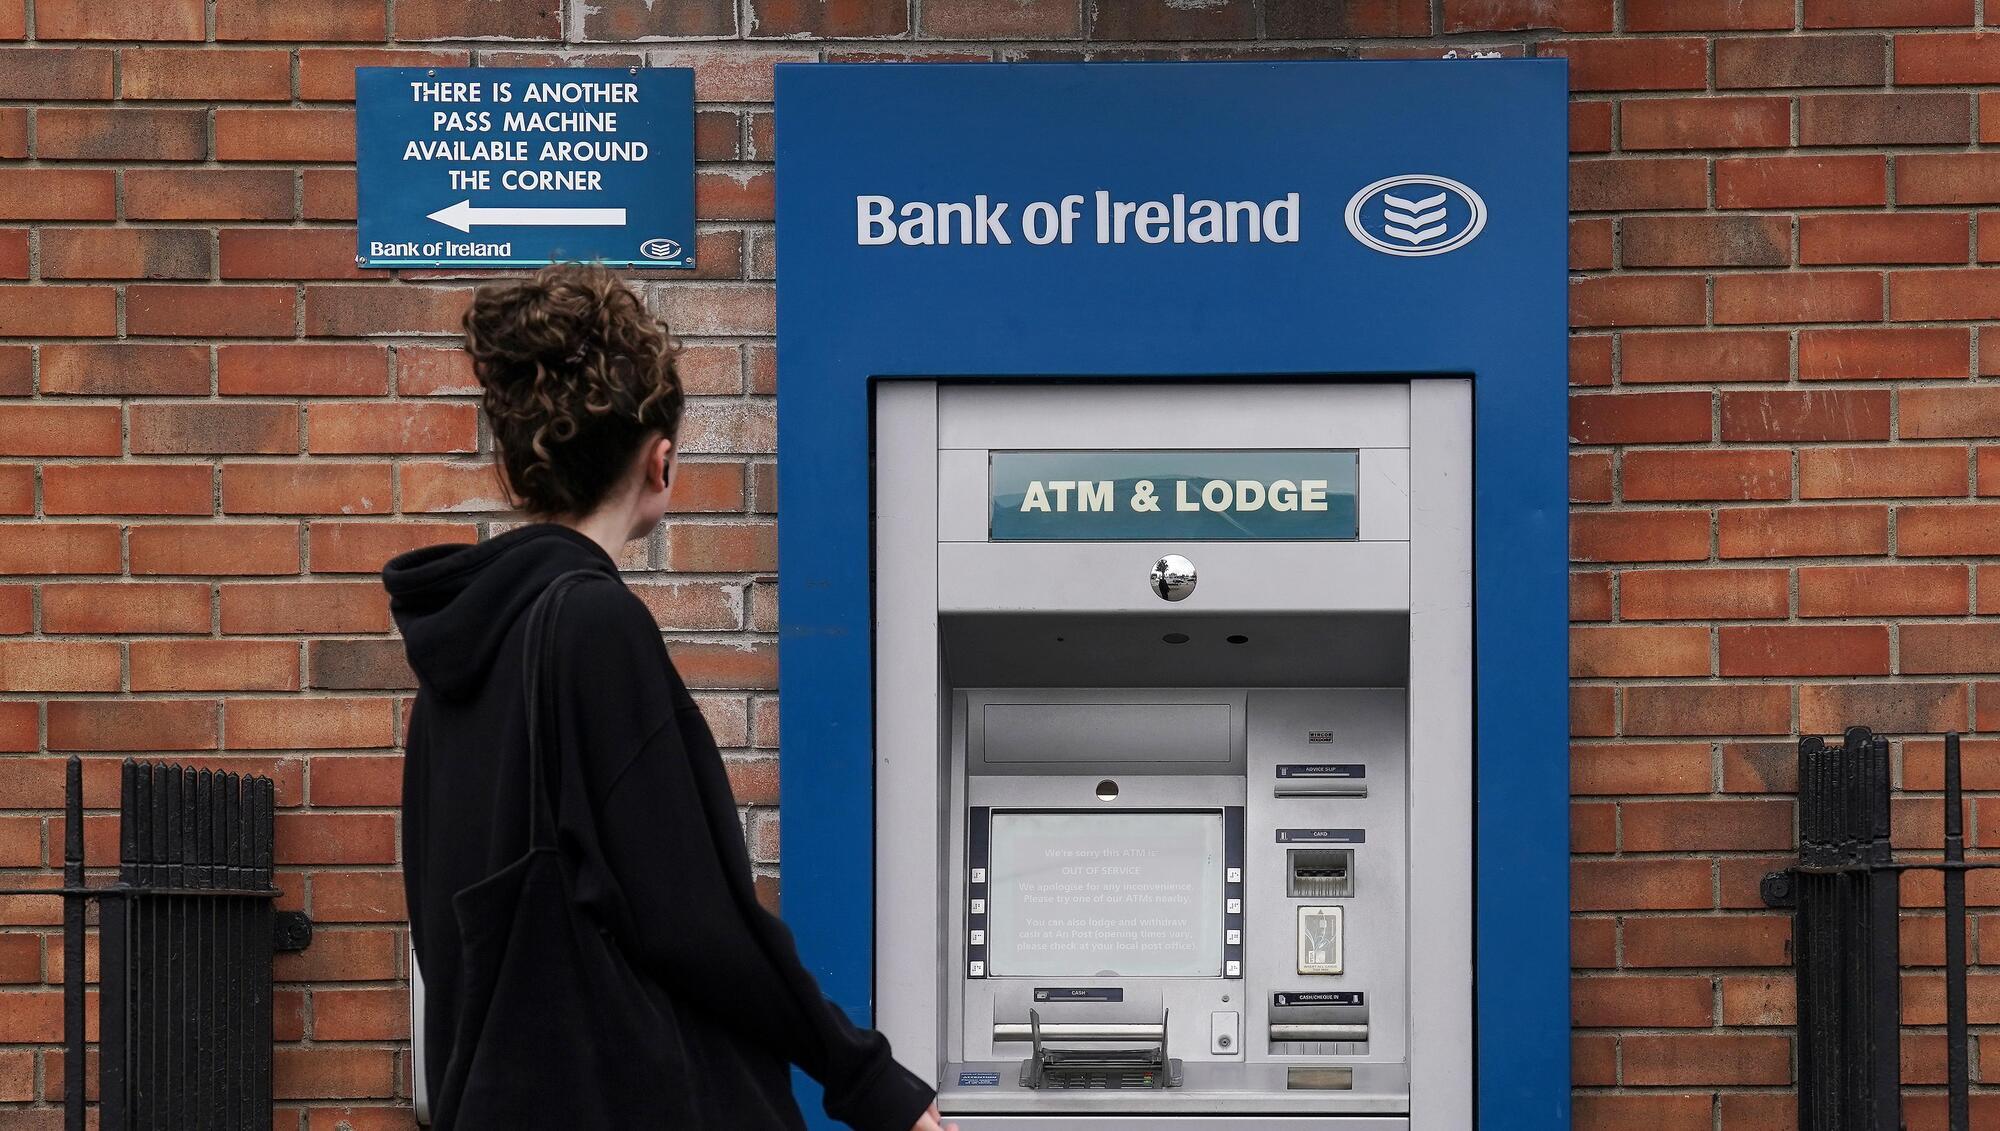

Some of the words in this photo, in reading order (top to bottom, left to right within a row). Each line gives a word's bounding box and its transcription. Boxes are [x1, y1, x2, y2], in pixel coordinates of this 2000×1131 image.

[411, 82, 481, 103] THERE
[493, 82, 512, 103] IS
[523, 82, 639, 103] ANOTHER
[433, 111, 491, 132] PASS
[503, 110, 617, 132] MACHINE
[402, 140, 528, 162] AVAILABLE
[539, 141, 648, 162] AROUND
[449, 170, 491, 190] THE
[502, 169, 603, 191] CORNER
[856, 194, 1012, 246] Bank
[1022, 194, 1085, 245] of
[1095, 190, 1300, 244] Ireland
[370, 241, 420, 257] Bank
[422, 241, 443, 257] of
[446, 241, 511, 257] Ireland
[1020, 480, 1114, 512] ATM
[1130, 479, 1161, 513] &
[1176, 479, 1328, 513] LODGE
[1044, 848, 1074, 858] We're
[1074, 850, 1099, 859] sorry
[1103, 848, 1120, 857] this
[1122, 848, 1146, 857] ATM
[1062, 866, 1084, 875] OUT
[1086, 866, 1101, 875] OF
[1102, 866, 1142, 875] SERVICE
[1018, 882, 1034, 891] We
[1036, 882, 1083, 893] apologise
[1086, 882, 1100, 891] for
[1103, 884, 1121, 893] any
[1024, 895, 1054, 904] Please
[1056, 895, 1072, 905] try
[1073, 896, 1091, 904] one
[1092, 895, 1105, 904] of
[1106, 896, 1123, 904] our
[1126, 895, 1153, 904] ATMs
[1025, 918, 1045, 927] You
[1047, 919, 1065, 927] can
[1066, 918, 1087, 927] also
[1088, 918, 1115, 929] lodge
[1118, 918, 1137, 927] and
[1139, 918, 1187, 927] withdraw
[1019, 929, 1040, 939] cash
[1043, 930, 1053, 939] at
[1055, 929, 1069, 939] An
[1071, 929, 1092, 939] Post
[1094, 929, 1138, 940] (opening
[1140, 929, 1166, 939] times
[1016, 942, 1048, 952] please
[1049, 942, 1078, 951] check
[1079, 943, 1090, 951] at
[1091, 943, 1114, 953] your
[1115, 942, 1139, 951] local
[1140, 942, 1163, 953] post
